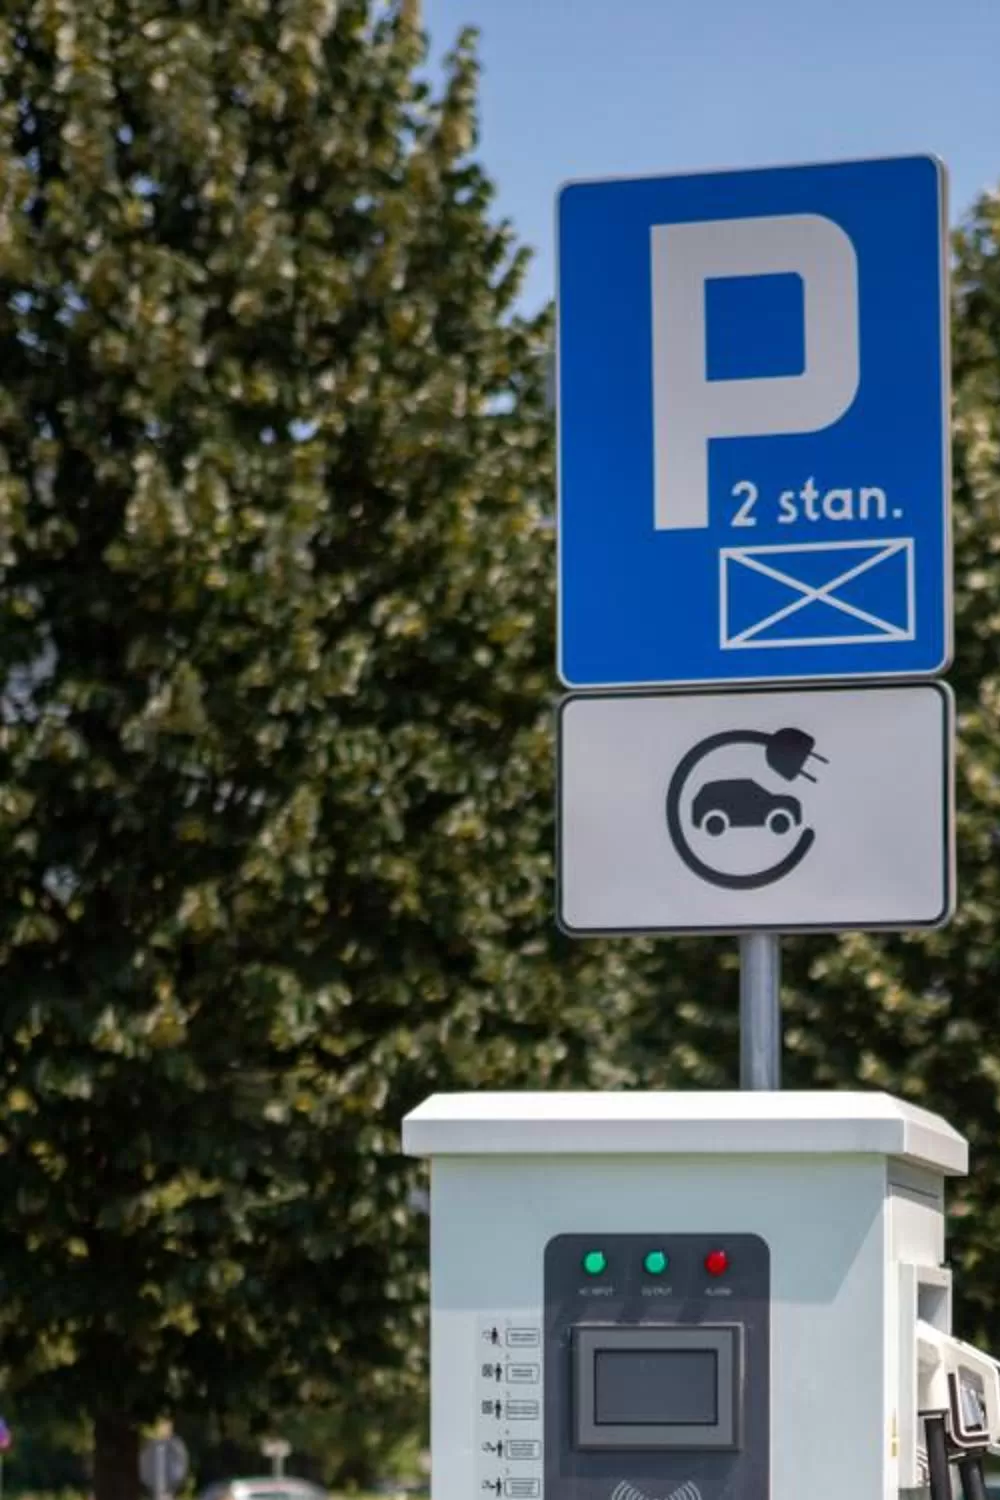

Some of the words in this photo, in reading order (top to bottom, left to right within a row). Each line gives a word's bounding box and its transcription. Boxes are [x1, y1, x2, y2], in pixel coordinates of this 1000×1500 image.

[650, 213, 860, 530] P
[730, 480, 758, 527] 2
[777, 476, 903, 524] stan.
